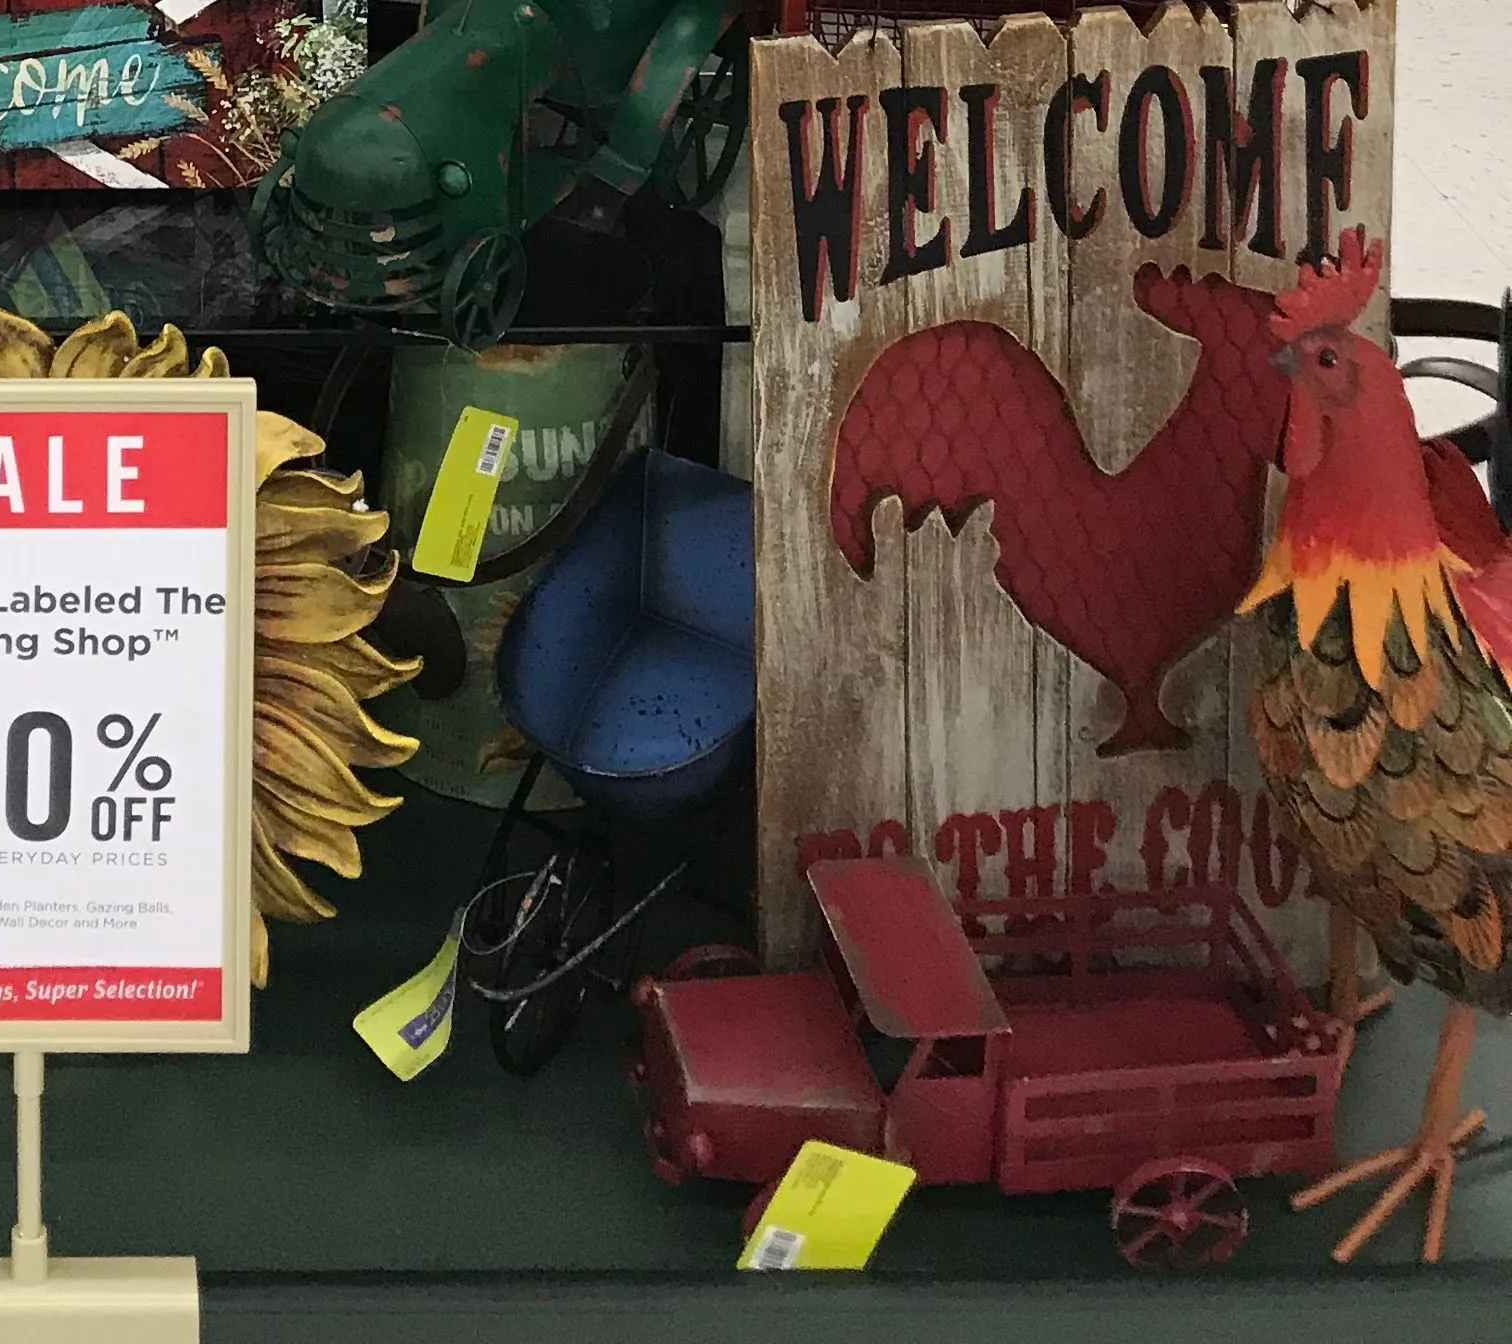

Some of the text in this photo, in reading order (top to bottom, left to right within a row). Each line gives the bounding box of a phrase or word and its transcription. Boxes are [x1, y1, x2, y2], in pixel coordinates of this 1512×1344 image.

[778, 49, 1369, 323] WELCOME
[156, 587, 227, 615] The
[91, 796, 176, 842] OFF
[92, 851, 169, 867] PRICES
[934, 799, 1118, 939] THE
[86, 900, 133, 917] Gazing
[28, 915, 70, 929] Decor
[73, 915, 99, 930] and
[102, 915, 138, 930] More
[25, 979, 89, 1004] Super
[93, 979, 199, 1001] Selection!
